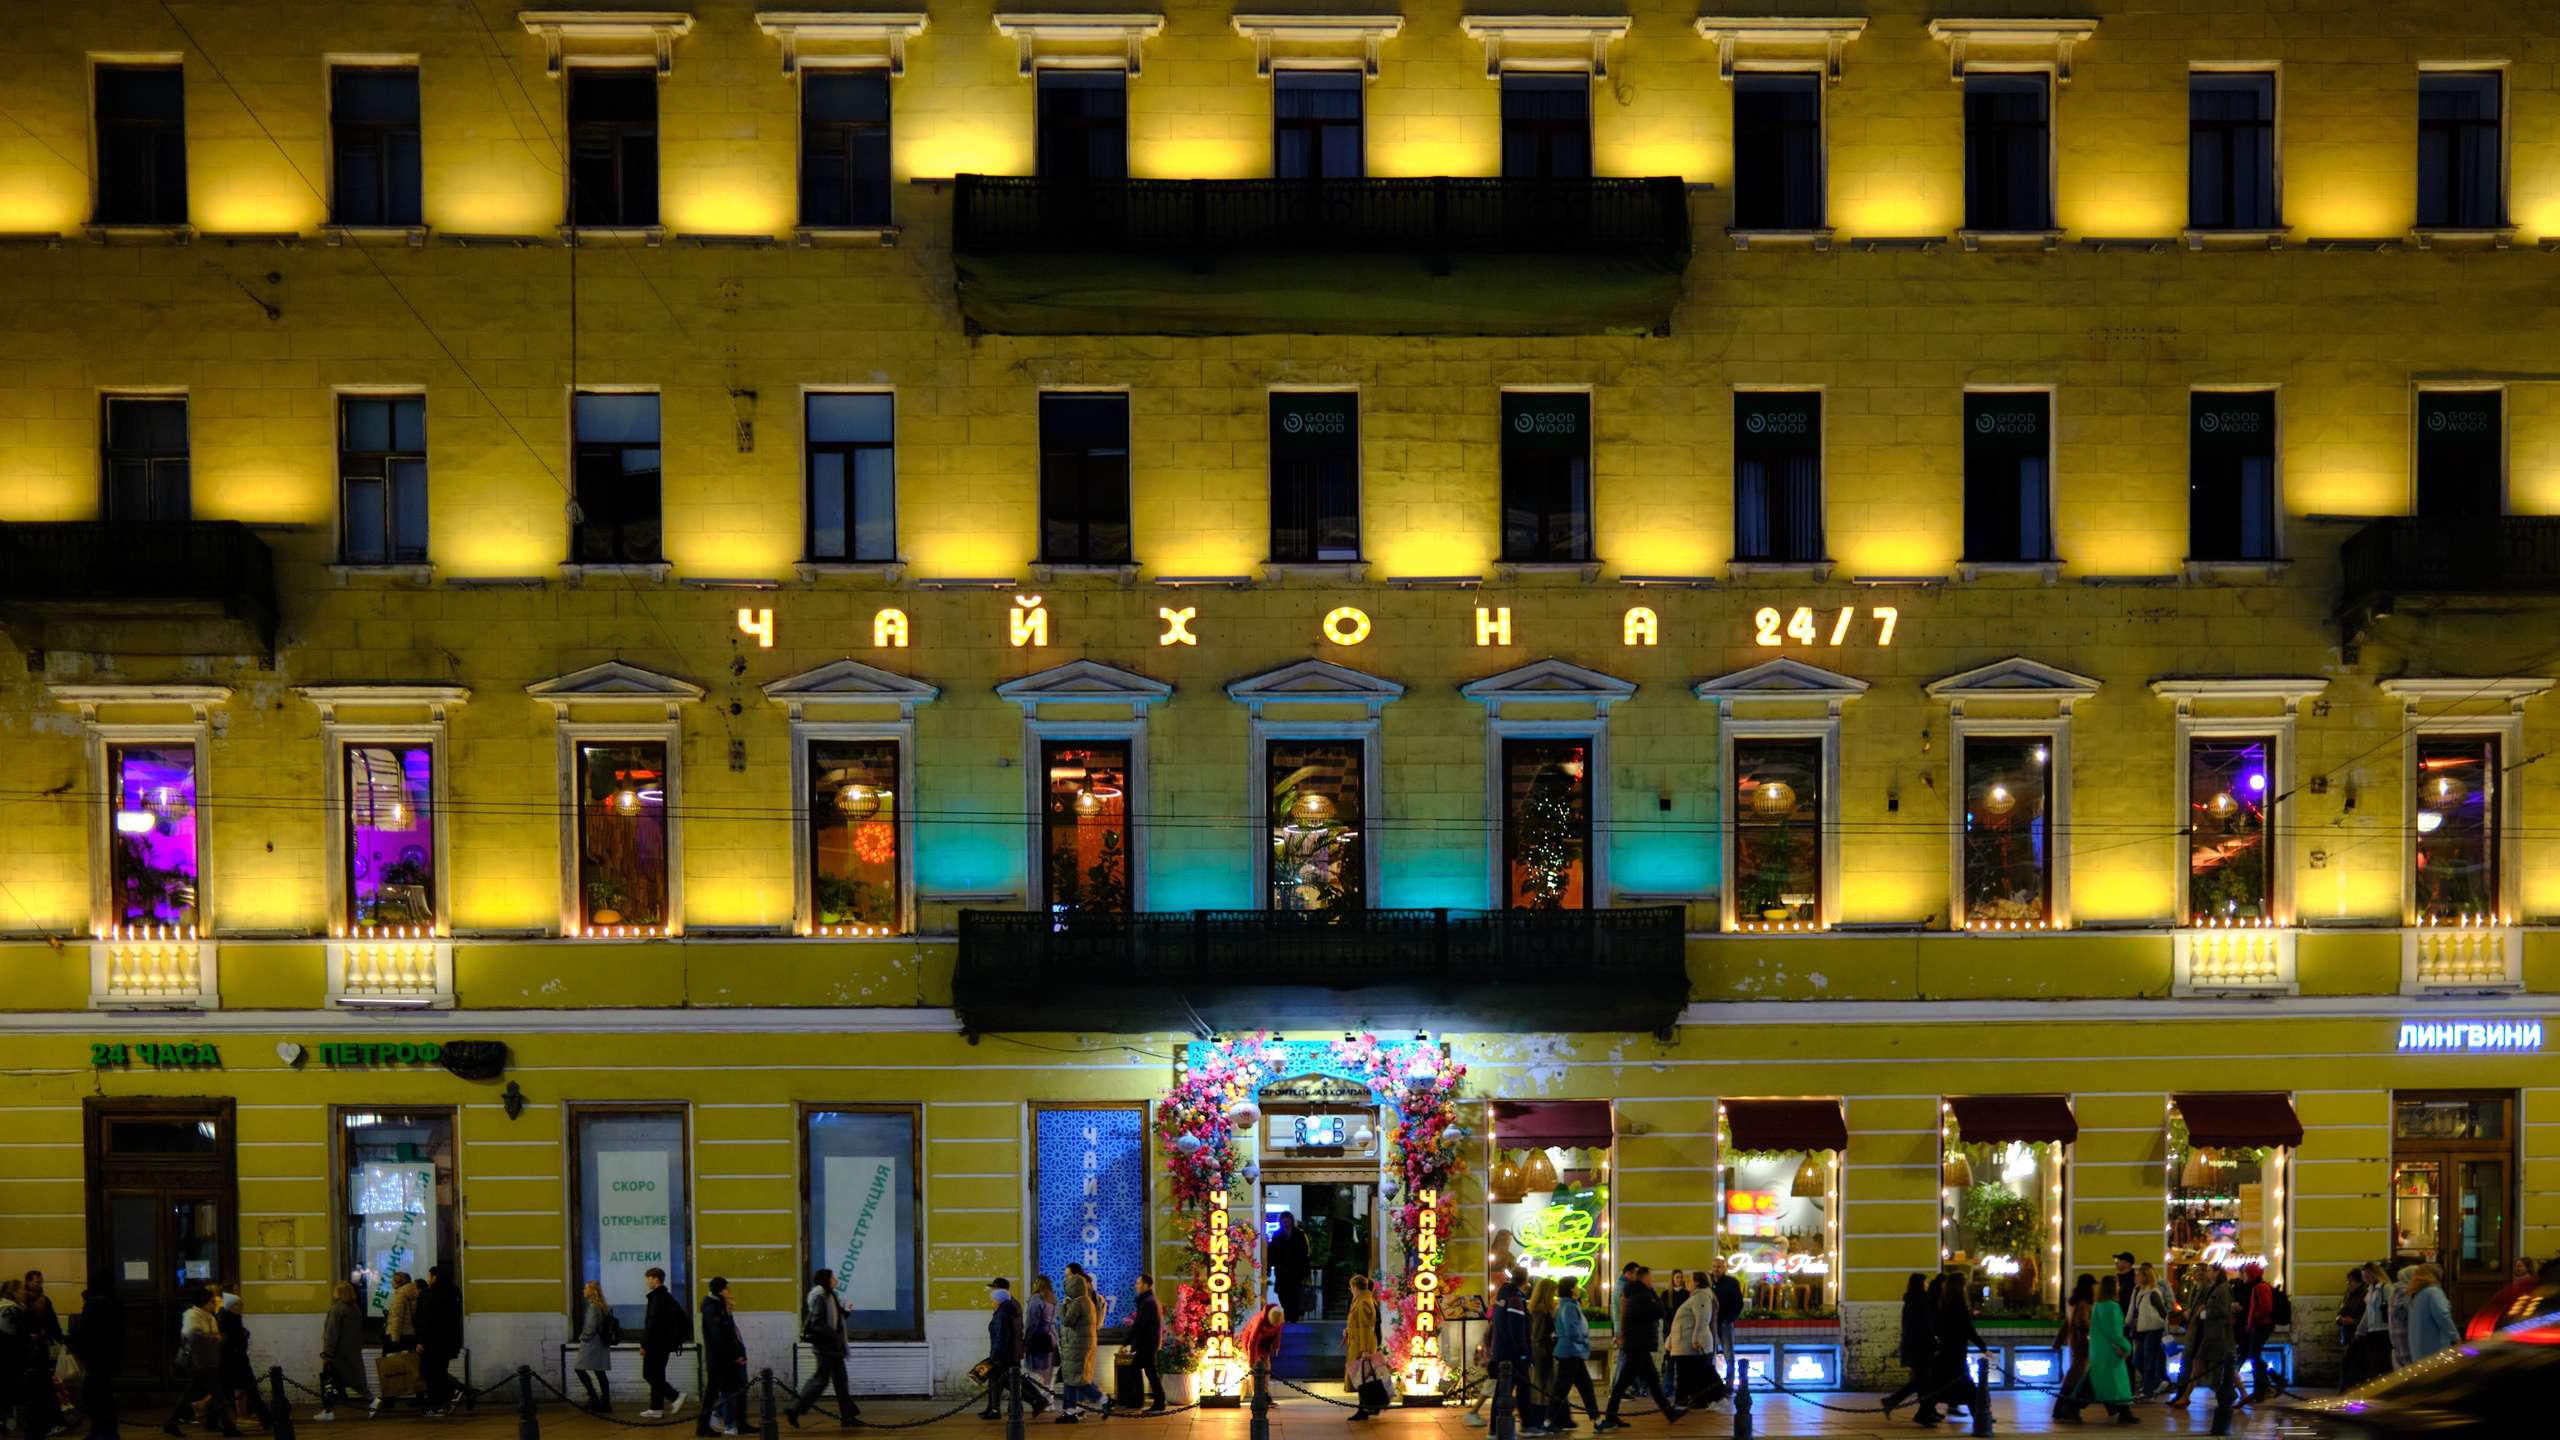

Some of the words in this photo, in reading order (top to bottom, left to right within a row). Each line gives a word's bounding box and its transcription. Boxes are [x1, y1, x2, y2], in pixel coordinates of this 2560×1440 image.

[1304, 413, 1345, 422] GOOD
[1535, 413, 1575, 422] GOOD
[1766, 413, 1807, 422] GOOD
[1996, 413, 2036, 422] GOOD
[2220, 412, 2260, 422] GOOD
[2448, 411, 2488, 420] GOOD
[1304, 423, 1345, 433] WOOD
[1535, 423, 1575, 433] WOOD
[1766, 423, 1807, 433] WOOD
[1996, 423, 2036, 433] WOOD
[2220, 422, 2260, 432] WOOD
[2448, 421, 2488, 431] WOOD
[738, 595, 1657, 647] ЧАЙХОНА
[1754, 606, 1898, 646] 24/7
[2398, 1021, 2542, 1049] ЛИНГВИНИ
[91, 1043, 125, 1065] 24
[135, 1043, 218, 1065] ЧАСА
[319, 1042, 441, 1064] ПЕТРОФ
[1294, 1116, 1345, 1130] GOOD
[1294, 1130, 1345, 1145] WOOD
[612, 1181, 656, 1192] СКОРО
[602, 1216, 668, 1227] ОТКРЫТИЕ
[835, 1164, 891, 1302] ЕКОНСТРУКЦИЯ
[372, 1170, 431, 1311] РЕКОНСТРУИЯ
[610, 1251, 662, 1262] АПТЕКИ
[1207, 1190, 1232, 1332] ЧАЙХОНА
[1413, 1189, 1439, 1332] ЧАЙХОНА
